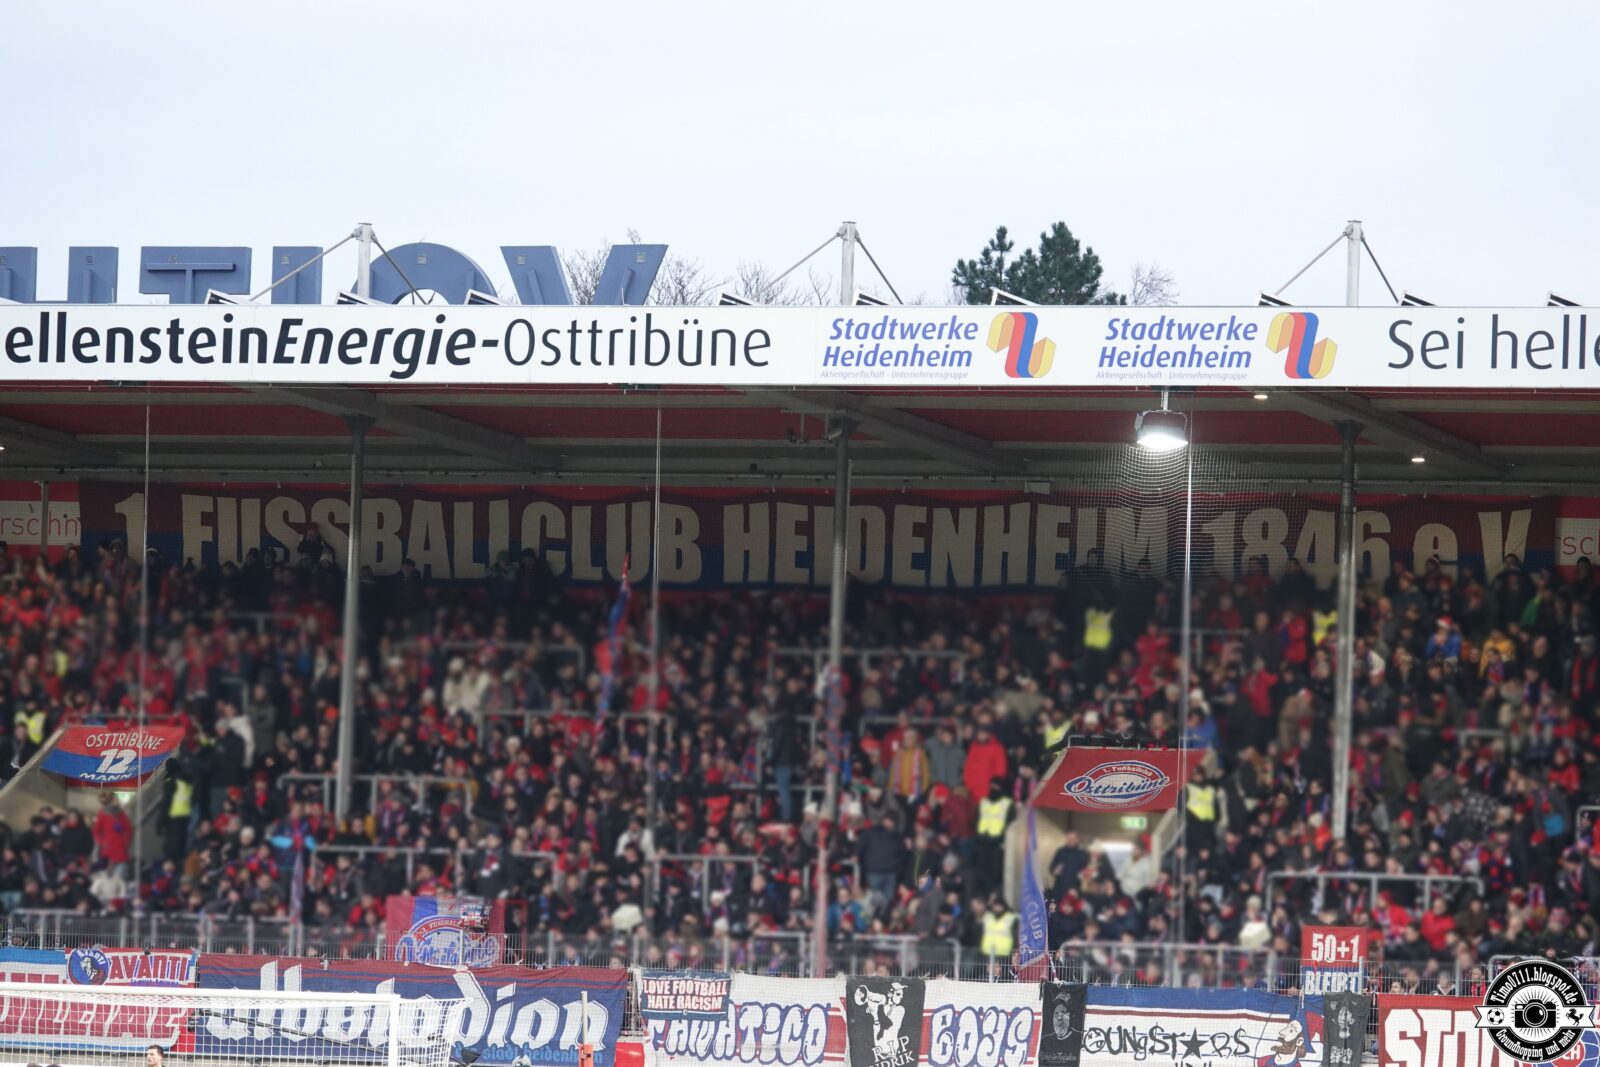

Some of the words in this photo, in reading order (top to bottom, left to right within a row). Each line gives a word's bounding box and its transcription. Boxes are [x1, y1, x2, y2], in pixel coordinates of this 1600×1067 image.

[830, 315, 979, 341] Stadtwerke
[1105, 315, 1258, 341] Stadtwerke
[1388, 319, 1465, 369] Sei
[1491, 314, 1600, 370] hell
[823, 343, 973, 367] Heidenheim
[1099, 344, 1252, 368] Heidenheim
[722, 501, 1170, 588] HEIDENHEIM
[1200, 508, 1391, 592] 1846
[96, 748, 137, 773] 12
[1311, 933, 1360, 963] 50+1
[643, 979, 670, 994] LOVE
[673, 980, 728, 996] FOOTBALL
[647, 995, 675, 1009] HATE
[677, 996, 723, 1011] RACISM
